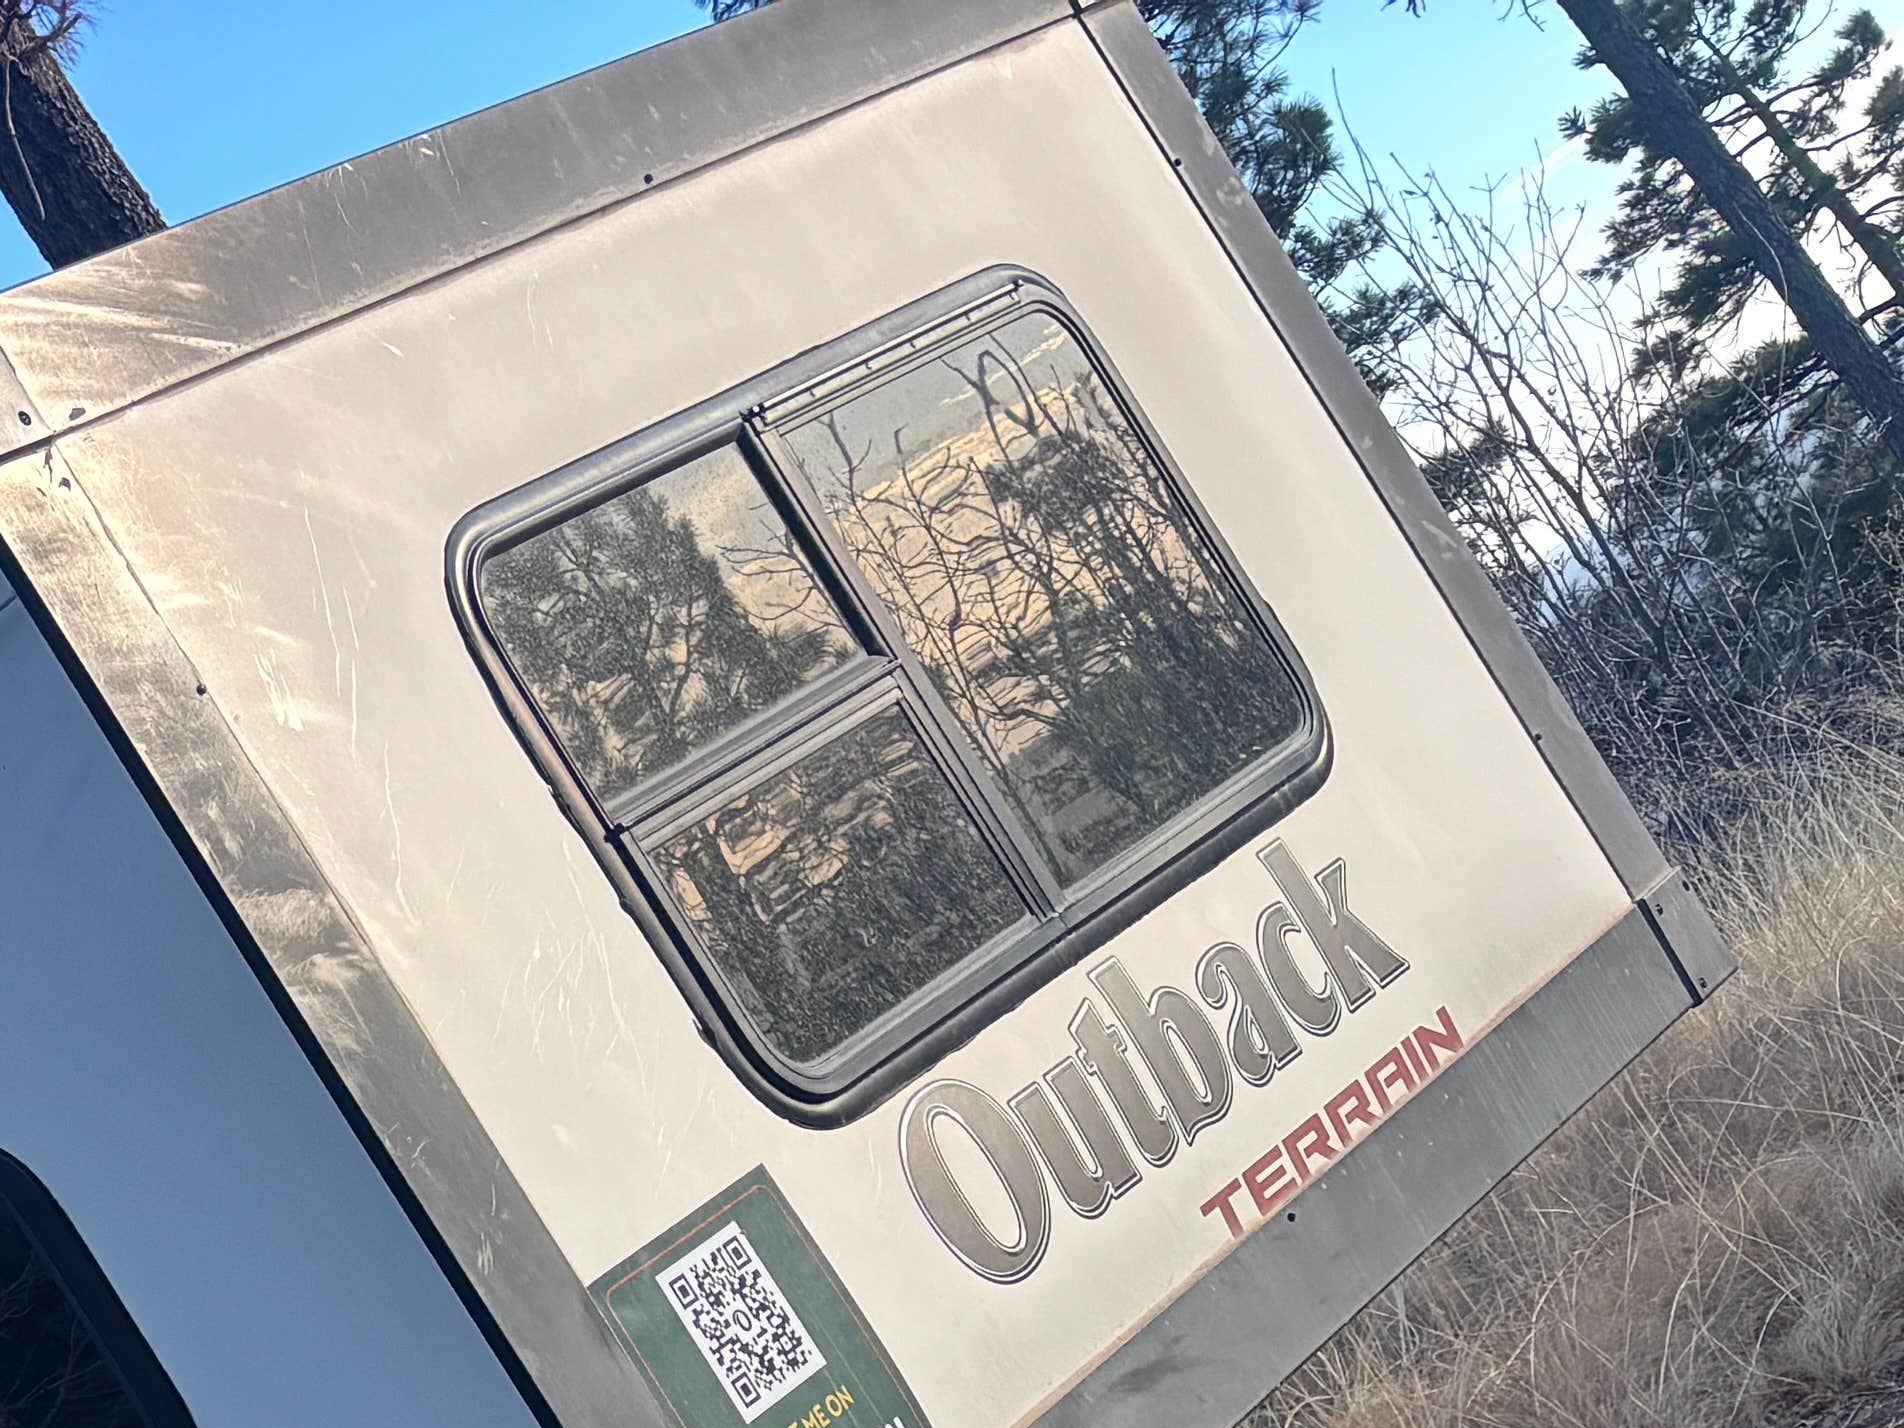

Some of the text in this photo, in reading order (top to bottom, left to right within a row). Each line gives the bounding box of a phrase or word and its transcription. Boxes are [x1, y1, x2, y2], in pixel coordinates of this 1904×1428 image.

[898, 836, 1411, 1285] Outback
[1199, 1006, 1466, 1239] TERRAIN
[825, 1385, 855, 1417] ON
